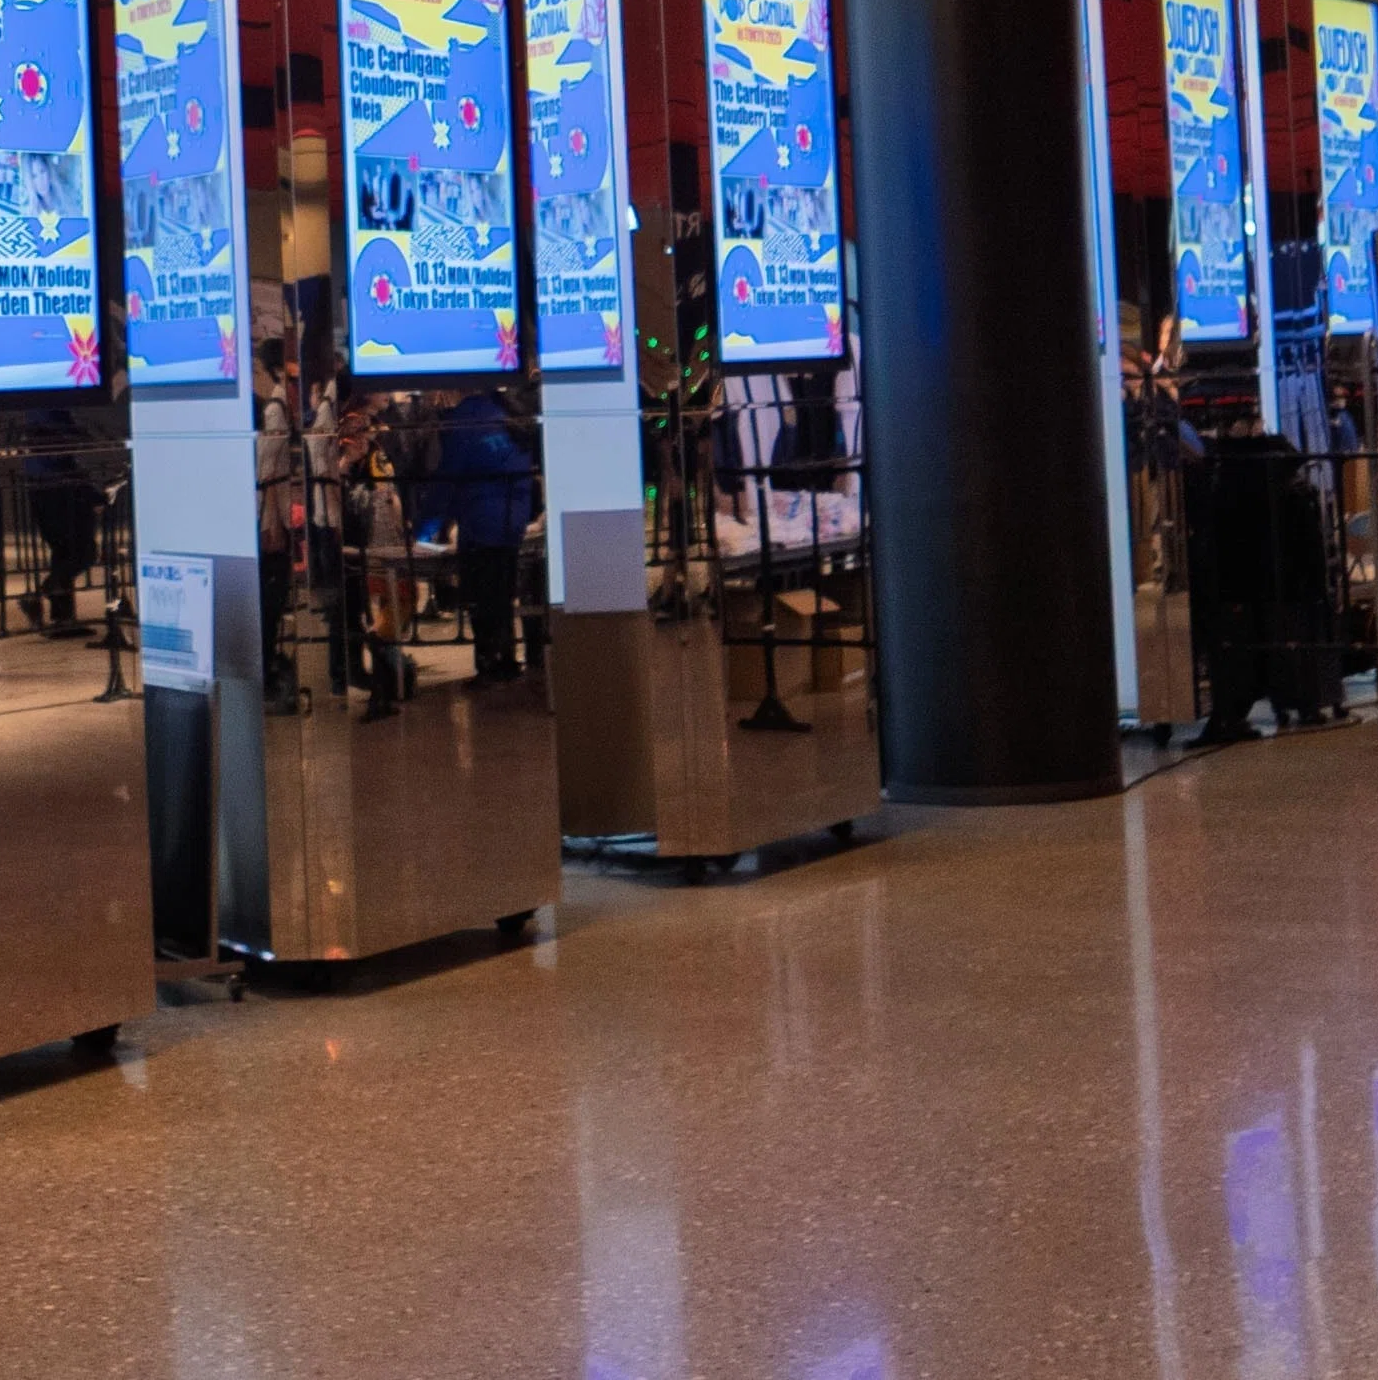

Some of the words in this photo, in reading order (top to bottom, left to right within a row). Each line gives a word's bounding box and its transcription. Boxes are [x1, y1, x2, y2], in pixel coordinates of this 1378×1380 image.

[1166, 0, 1220, 56] SWEDISH
[347, 41, 374, 68] The
[378, 45, 450, 77] Cardigans
[350, 71, 420, 100] Cloudberry
[414, 261, 446, 285] 10.13
[33, 292, 92, 316] Theater
[396, 288, 429, 310] Tokyo
[431, 289, 470, 309] Garden
